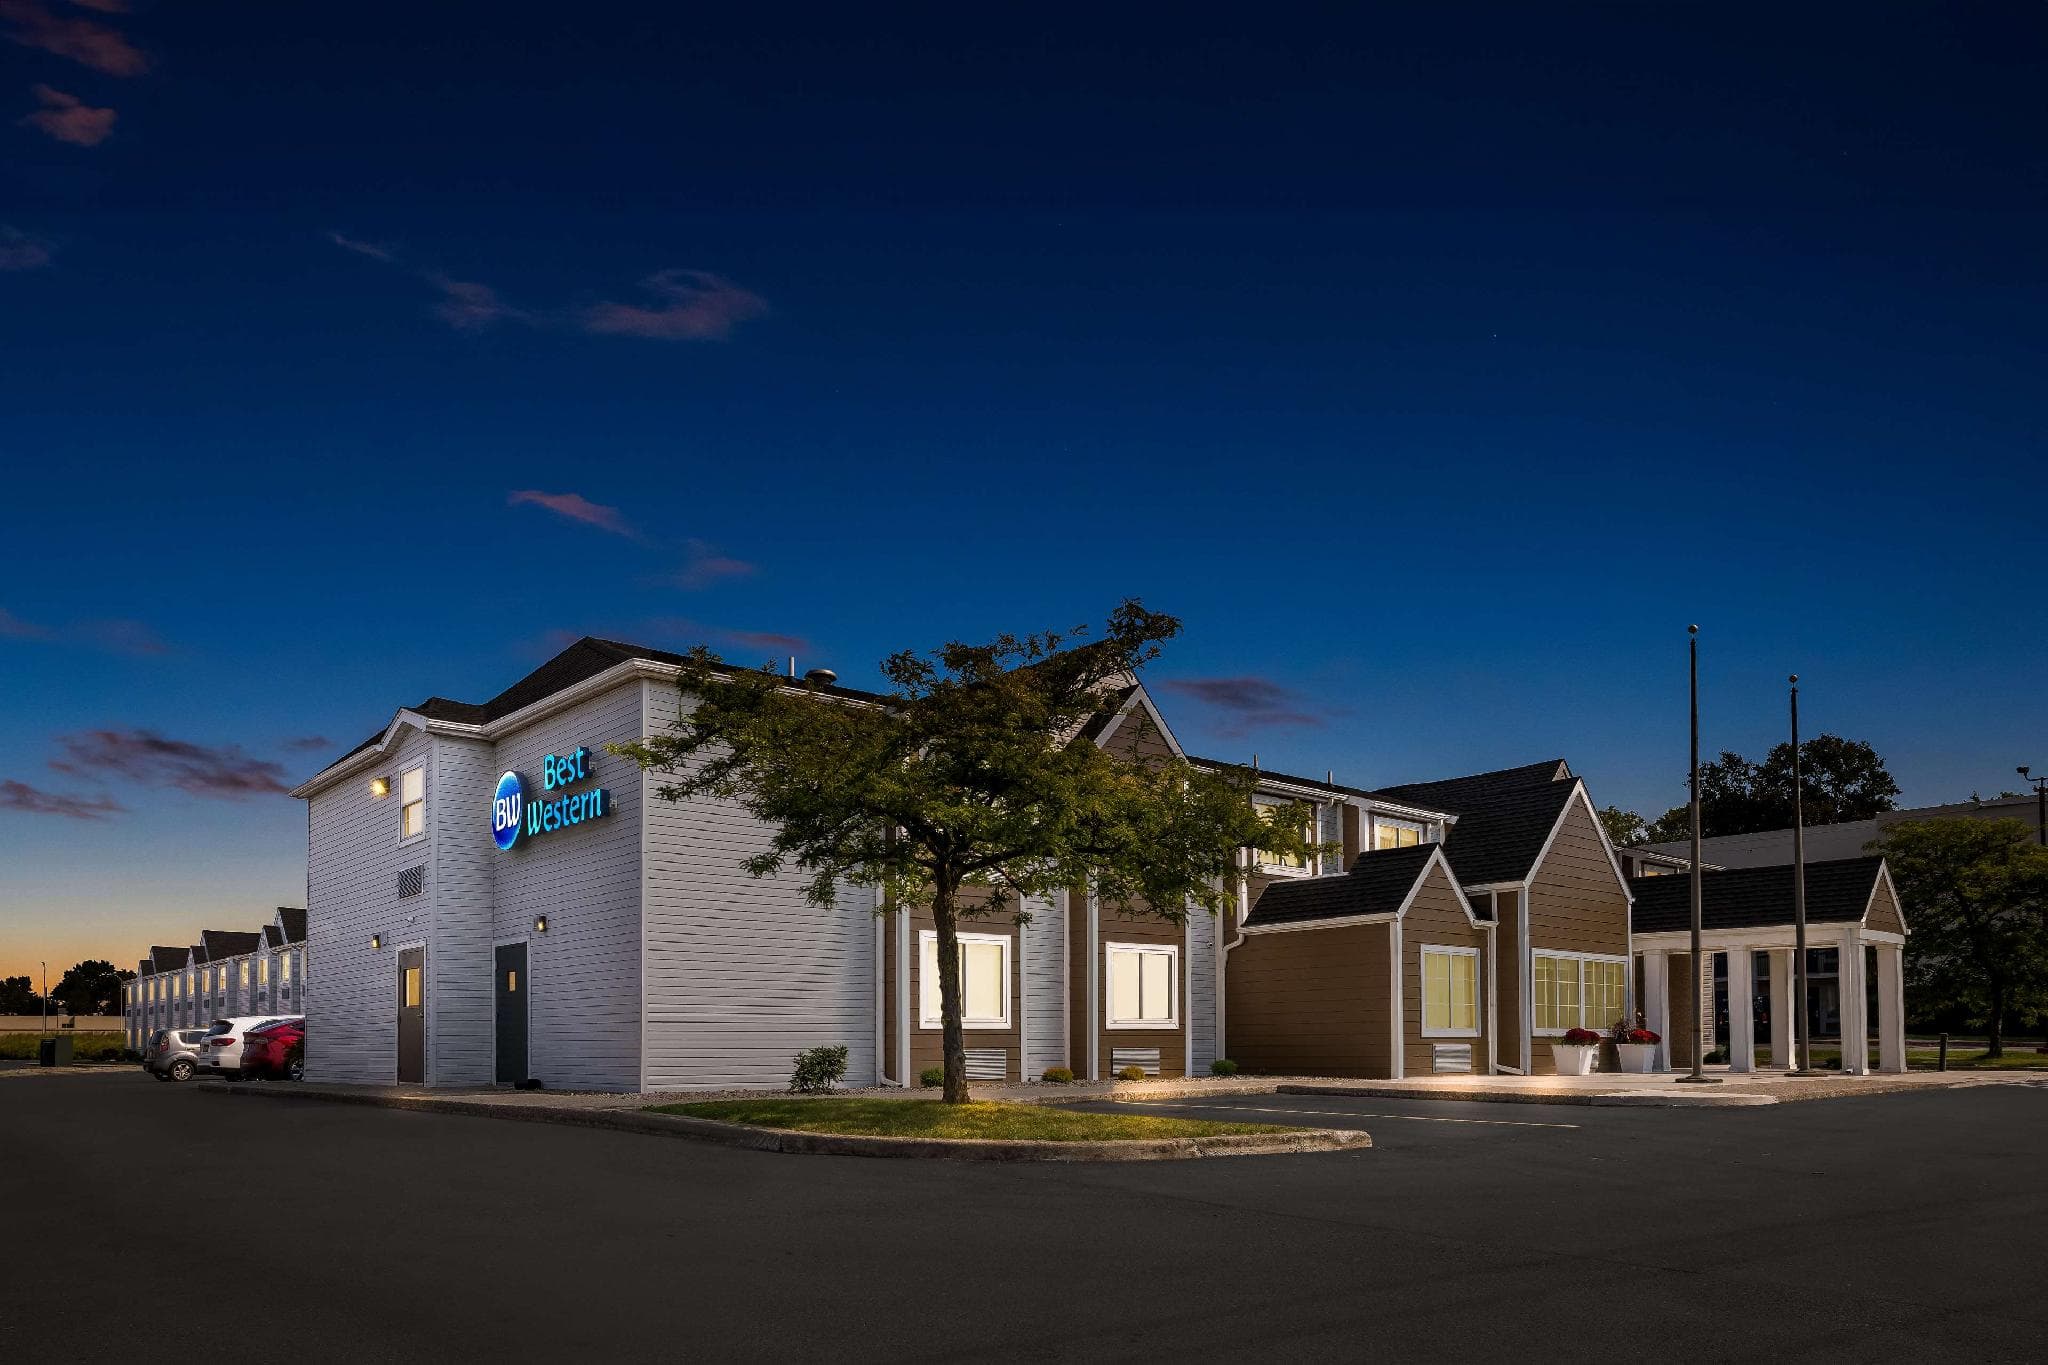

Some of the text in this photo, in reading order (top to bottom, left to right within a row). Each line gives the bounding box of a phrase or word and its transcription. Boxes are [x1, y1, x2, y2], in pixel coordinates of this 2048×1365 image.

[543, 745, 585, 791] Best
[495, 792, 521, 832] BW
[527, 788, 602, 837] Western
